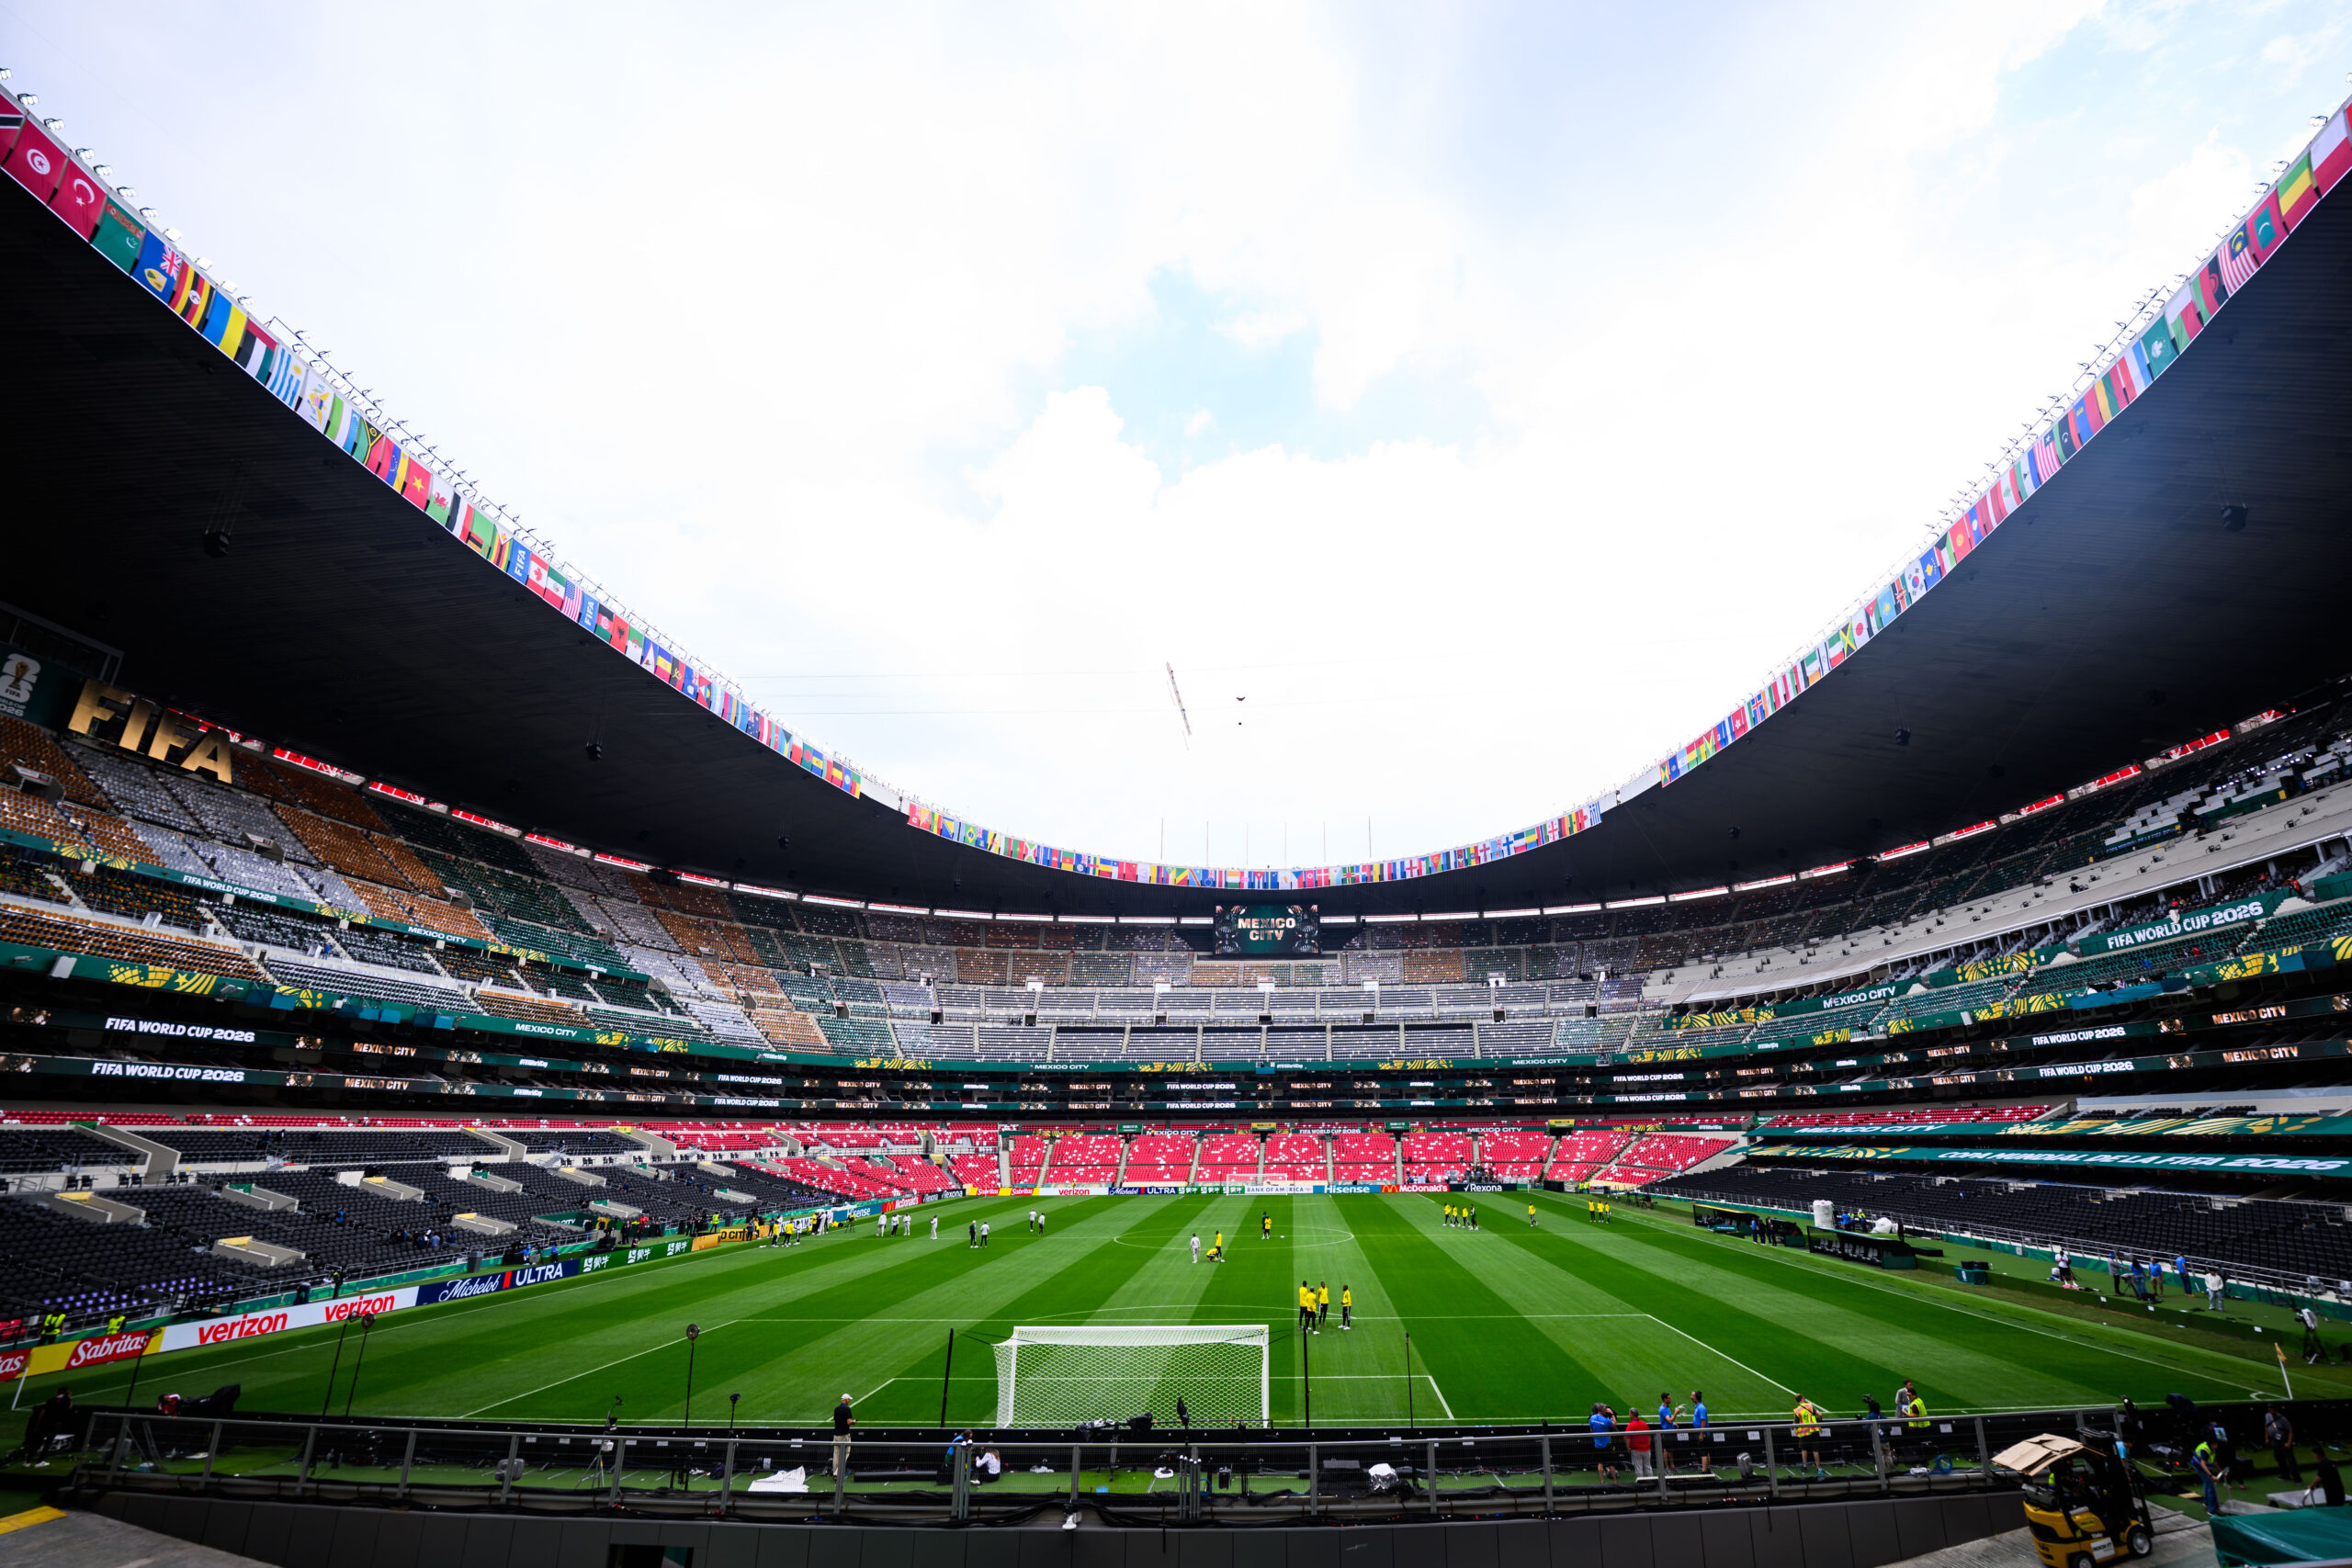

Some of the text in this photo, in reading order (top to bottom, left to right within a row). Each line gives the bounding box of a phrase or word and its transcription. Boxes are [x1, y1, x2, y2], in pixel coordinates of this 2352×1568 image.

[514, 549, 526, 577] FIFA
[584, 601, 594, 626] FIFA
[5, 688, 21, 698] FIFA
[0, 703, 24, 716] 026
[67, 679, 232, 784] FIFA
[183, 874, 277, 903] FIFA WORLD CUP 2026
[1238, 918, 1296, 929] MEXICO
[2107, 901, 2264, 950] FIFA WORLD CUP 2026
[407, 926, 468, 944] MEXICO CITY
[1250, 930, 1284, 941] CITY
[1823, 986, 1896, 1009] MEXICO CITY
[2211, 1005, 2287, 1025] MEXICO CITY
[105, 1017, 255, 1043] FIFA WORLD CUP 2026
[514, 1022, 578, 1038] MEXICO CITY
[2032, 1026, 2126, 1046] FIFA WORLD CUP 2026
[353, 1042, 417, 1056] MEXICO CITY
[1927, 1045, 1971, 1057] MEXICO CITY
[2222, 1045, 2299, 1063] MEXICO CITY
[91, 1062, 245, 1082] FIFA WORLD CUP 2026
[630, 1067, 671, 1078] MEXICO CITY
[2040, 1061, 2134, 1077] FIFA WORLD CUP 2026
[345, 1077, 410, 1091] MEXICO CITY
[729, 1075, 750, 1083] WORLD
[750, 1076, 762, 1084] CUP
[761, 1077, 783, 1085] 2026
[1932, 1075, 1976, 1085] MEXICO CITY
[626, 1094, 650, 1102] MEXICO
[1881, 1124, 1948, 1133] CITY
[1938, 1151, 2350, 1170] COPA MUNDIAL DE LA FIFA 2026
[1058, 1188, 1090, 1196] verizon
[1324, 1185, 1370, 1193] Hisense
[1398, 1184, 1448, 1192] McDonald's
[1470, 1183, 1502, 1192] Rexona
[438, 1262, 563, 1303] Michelob ULTRA
[325, 1294, 395, 1322] verizon
[198, 1312, 288, 1345] verizon
[71, 1334, 149, 1367] Sabritas
